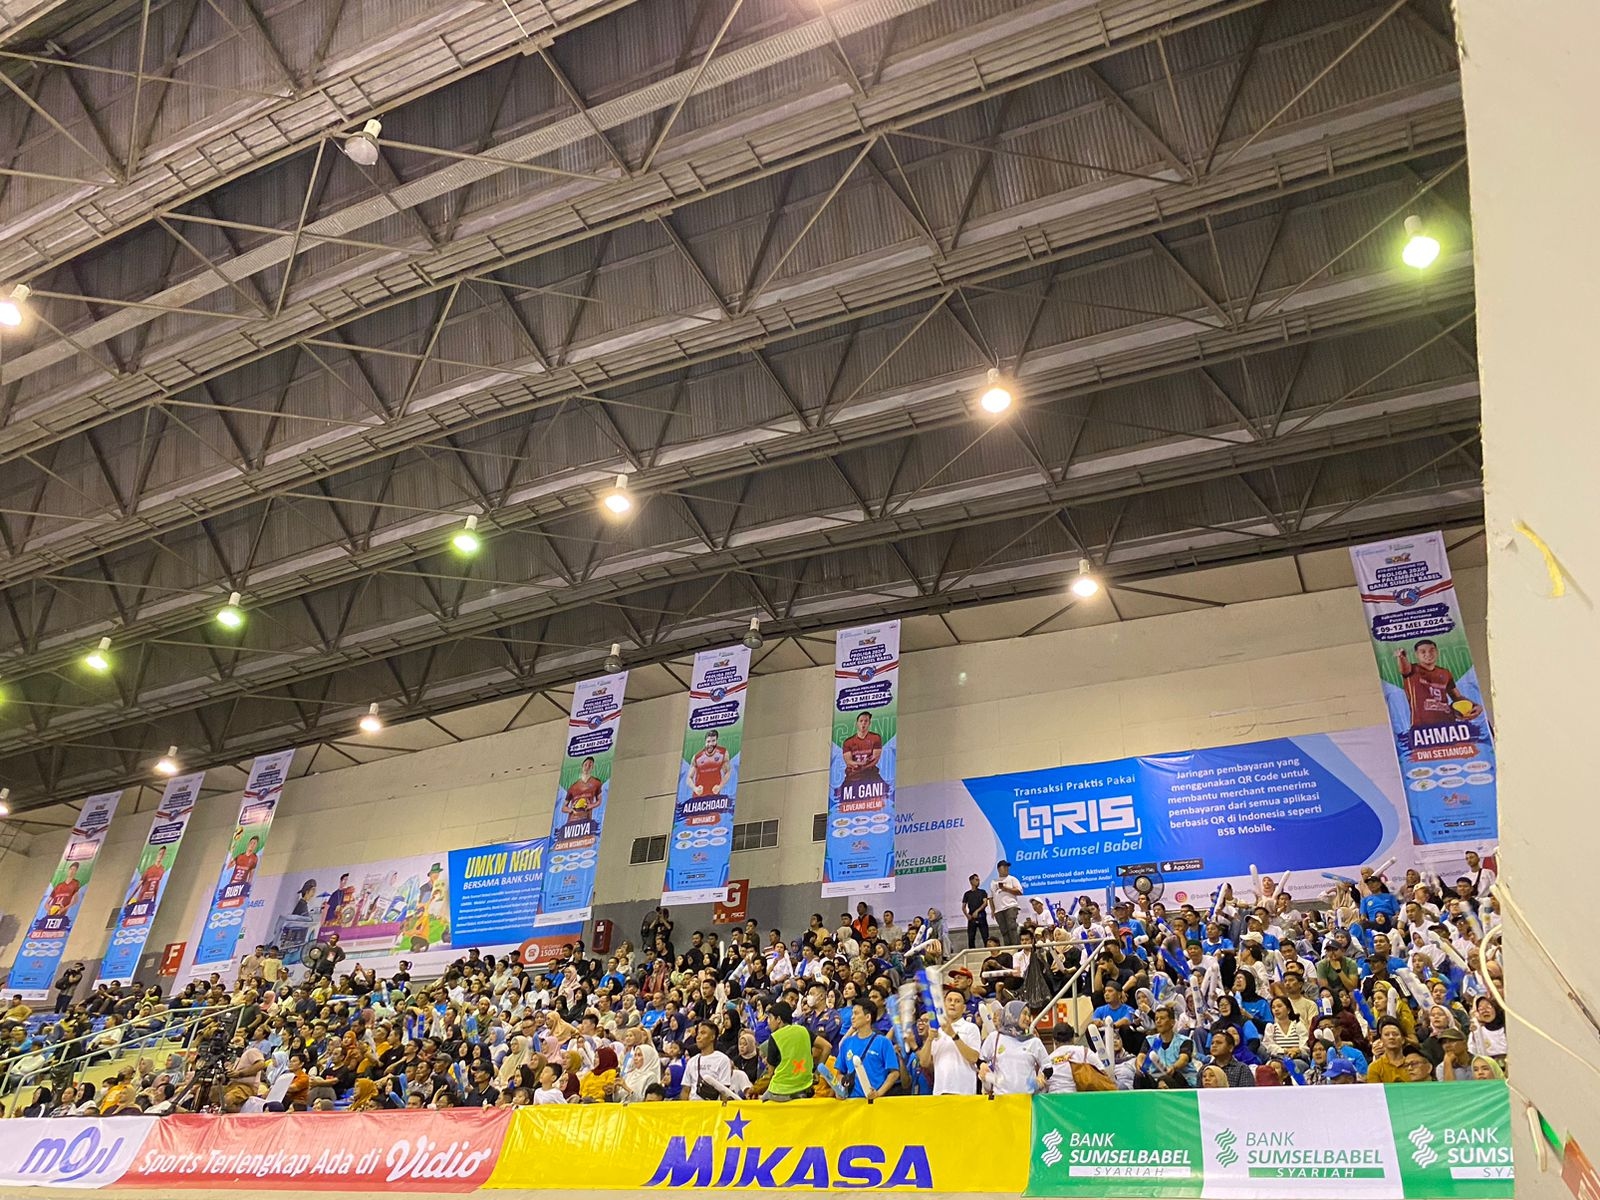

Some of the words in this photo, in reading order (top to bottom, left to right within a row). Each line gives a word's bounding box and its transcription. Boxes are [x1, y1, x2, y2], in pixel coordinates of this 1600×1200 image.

[1377, 569, 1408, 579] PROLIGA
[1381, 572, 1425, 583] PALEMBANG
[1389, 578, 1417, 587] SUMSEL
[1380, 624, 1403, 633] 09-12
[1405, 621, 1421, 629] MEI
[1424, 617, 1445, 626] 2024
[1414, 725, 1471, 746] AHMAD
[1417, 750, 1432, 760] DWI
[1432, 746, 1474, 759] SETIANGGA
[1176, 769, 1215, 780] Jaringan
[1217, 761, 1275, 776] pembayaran
[1277, 758, 1300, 769] yang
[1014, 783, 1064, 797] Transaksi
[1066, 778, 1104, 791] Praktis
[1106, 774, 1136, 786] Pakai
[1171, 778, 1236, 792] menggunakan
[1238, 775, 1252, 785] QR
[1254, 772, 1279, 782] Code
[1281, 768, 1310, 779] untuk
[843, 786, 856, 800] M.
[858, 783, 883, 799] GANI
[1168, 790, 1218, 804] membantu
[1220, 786, 1265, 798] merchant
[1267, 781, 1317, 793] menerima
[683, 798, 729, 813] ALHACHDADI
[1168, 804, 1226, 818] pembayaran
[1228, 801, 1247, 810] dari
[1248, 797, 1281, 808] semua
[1282, 792, 1320, 805] aplikasi
[1018, 795, 1136, 845] QRIS
[1170, 817, 1209, 829] berbasis
[1210, 815, 1225, 825] QR
[1227, 813, 1236, 823] di
[1238, 808, 1286, 822] Indonesia
[1287, 804, 1322, 817] seperti
[564, 822, 591, 839] WIDYA
[1217, 827, 1236, 837] BSB
[1238, 823, 1276, 835] Mobile.
[1015, 848, 1049, 862] Bank
[1052, 842, 1100, 858] Sumsel
[1103, 837, 1143, 853] Babel
[464, 852, 507, 880] UMKM
[509, 846, 544, 873] NAIK
[463, 879, 500, 890] BERSAMA
[501, 875, 523, 886] BANK
[524, 872, 543, 883] SUM
[1021, 874, 1041, 882] Segera
[1042, 870, 1072, 879] Download
[1085, 867, 1110, 875] Aktivasi
[225, 884, 245, 898] RUBY
[722, 882, 741, 908] G
[45, 919, 62, 930] TEDI
[167, 944, 181, 965] F
[1069, 1132, 1114, 1148] BANK
[1245, 1132, 1296, 1148] BANK
[1443, 1127, 1500, 1145] BANK
[138, 1148, 200, 1175] Sports
[202, 1148, 308, 1179] Terlengkap
[309, 1147, 352, 1175] Ada
[355, 1146, 381, 1175] di
[384, 1135, 493, 1182] Vidio
[641, 1136, 934, 1189] MIKASA
[1069, 1148, 1192, 1166] SUMSELBABEL
[1247, 1148, 1385, 1166] SUMSELBABEL
[1093, 1166, 1167, 1178] SYARIAH
[1273, 1167, 1357, 1179] SYARIAH
